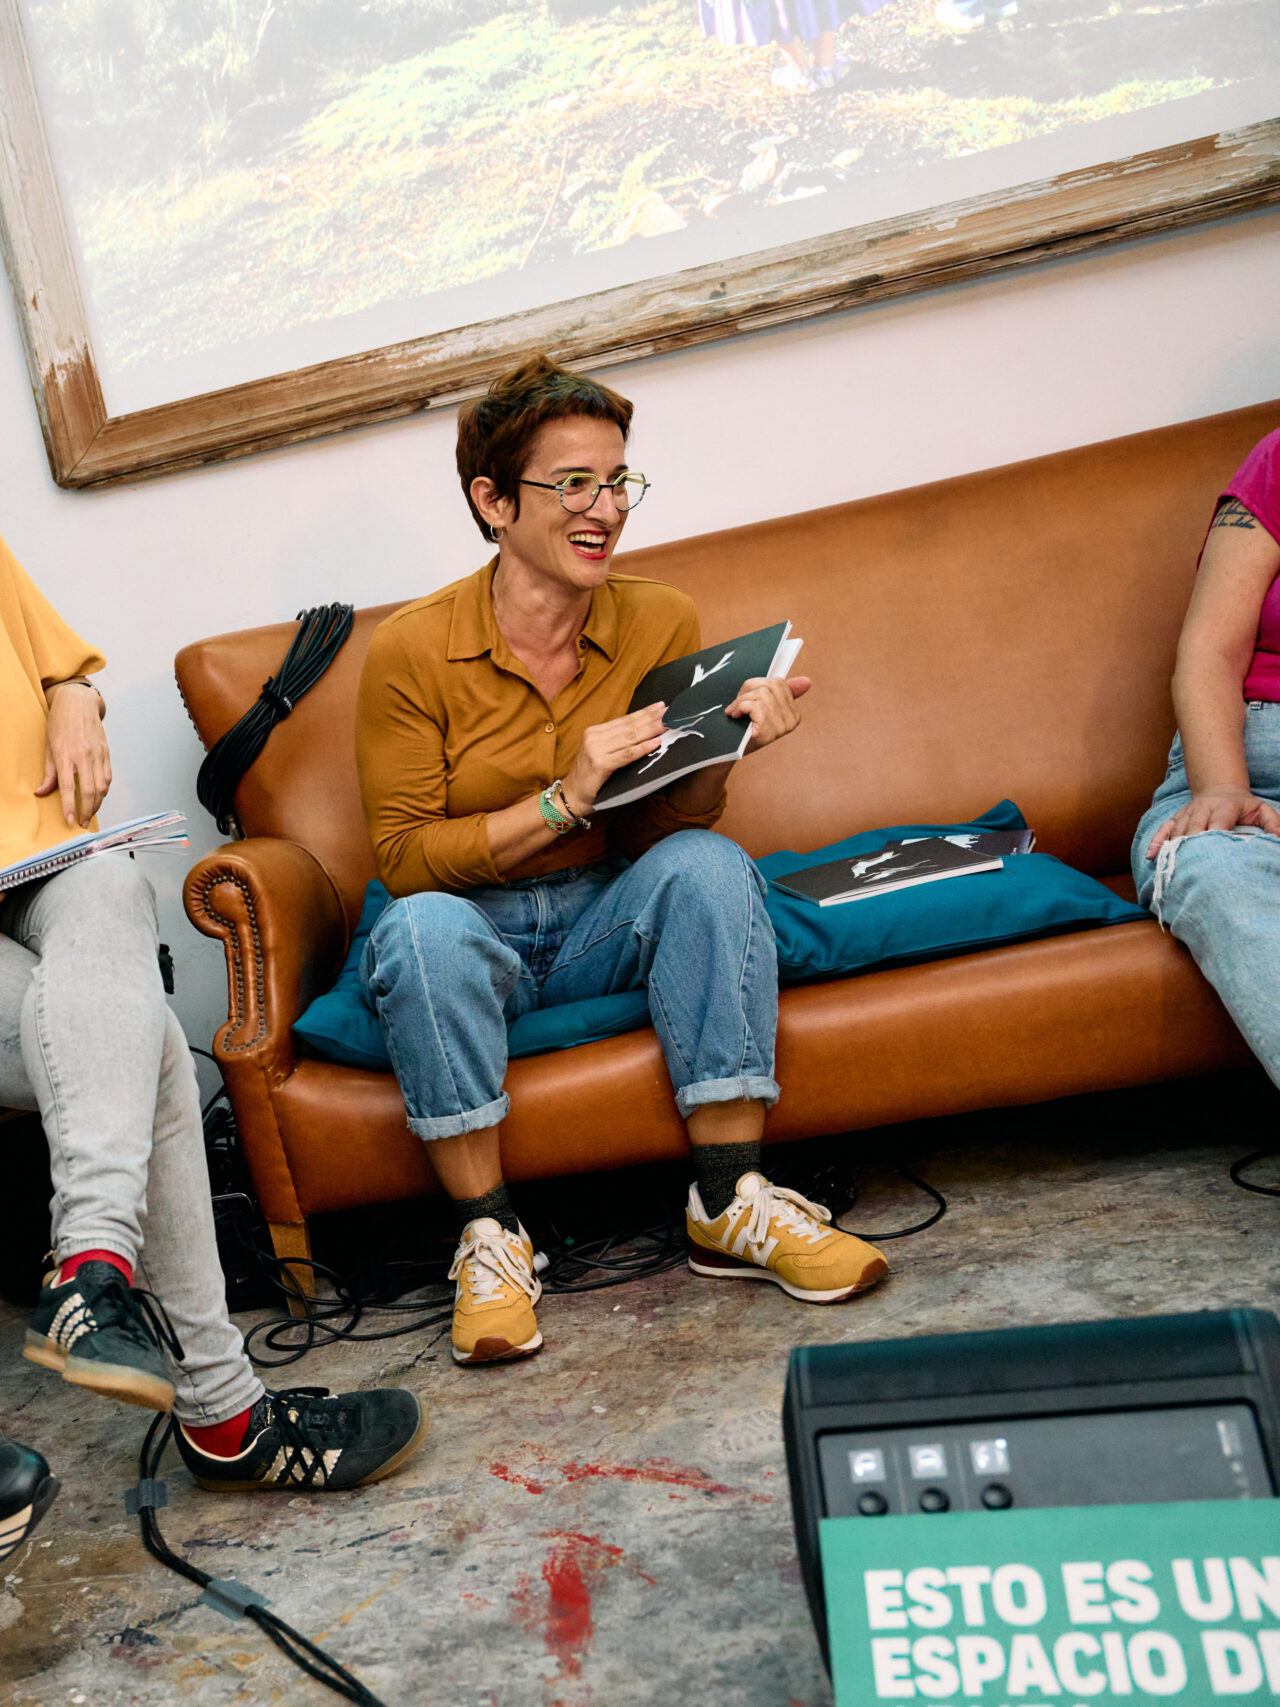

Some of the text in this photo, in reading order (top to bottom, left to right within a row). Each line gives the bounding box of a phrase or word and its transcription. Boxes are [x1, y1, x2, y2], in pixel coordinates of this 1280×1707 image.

[863, 1563, 1048, 1630] ESTO
[1061, 1559, 1161, 1625] ES
[871, 1630, 1189, 1698] ESPACIO
